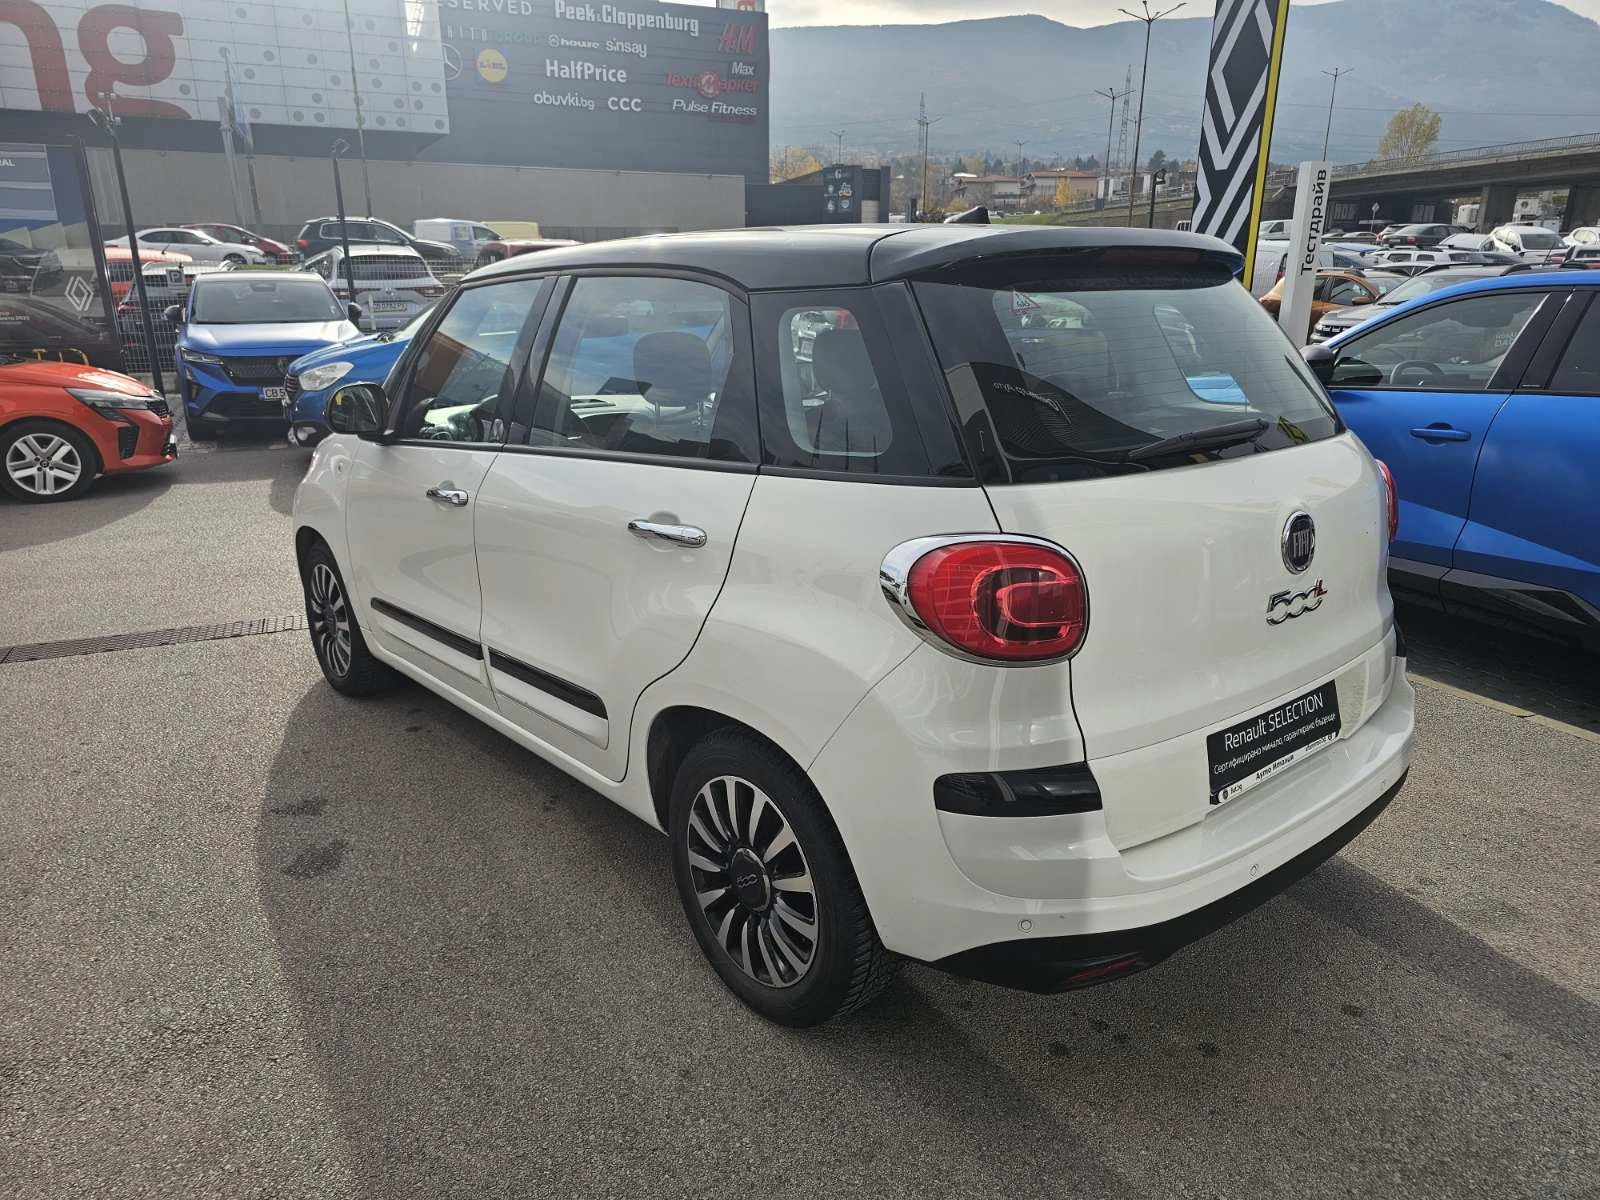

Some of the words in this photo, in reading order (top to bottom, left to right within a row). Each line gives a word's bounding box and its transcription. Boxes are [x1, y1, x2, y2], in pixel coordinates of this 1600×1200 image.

[437, 0, 532, 15] SERVED
[545, 58, 627, 83] HalfPrice
[731, 61, 755, 76] Max
[534, 90, 596, 111] obuvki.bg
[672, 99, 709, 113] Pulse
[710, 101, 758, 116] Fitness
[1300, 168, 1327, 276] Тестдрайв
[1292, 527, 1311, 559] FIAT
[1224, 719, 1268, 752] Renault
[1268, 692, 1324, 732] SELECTION
